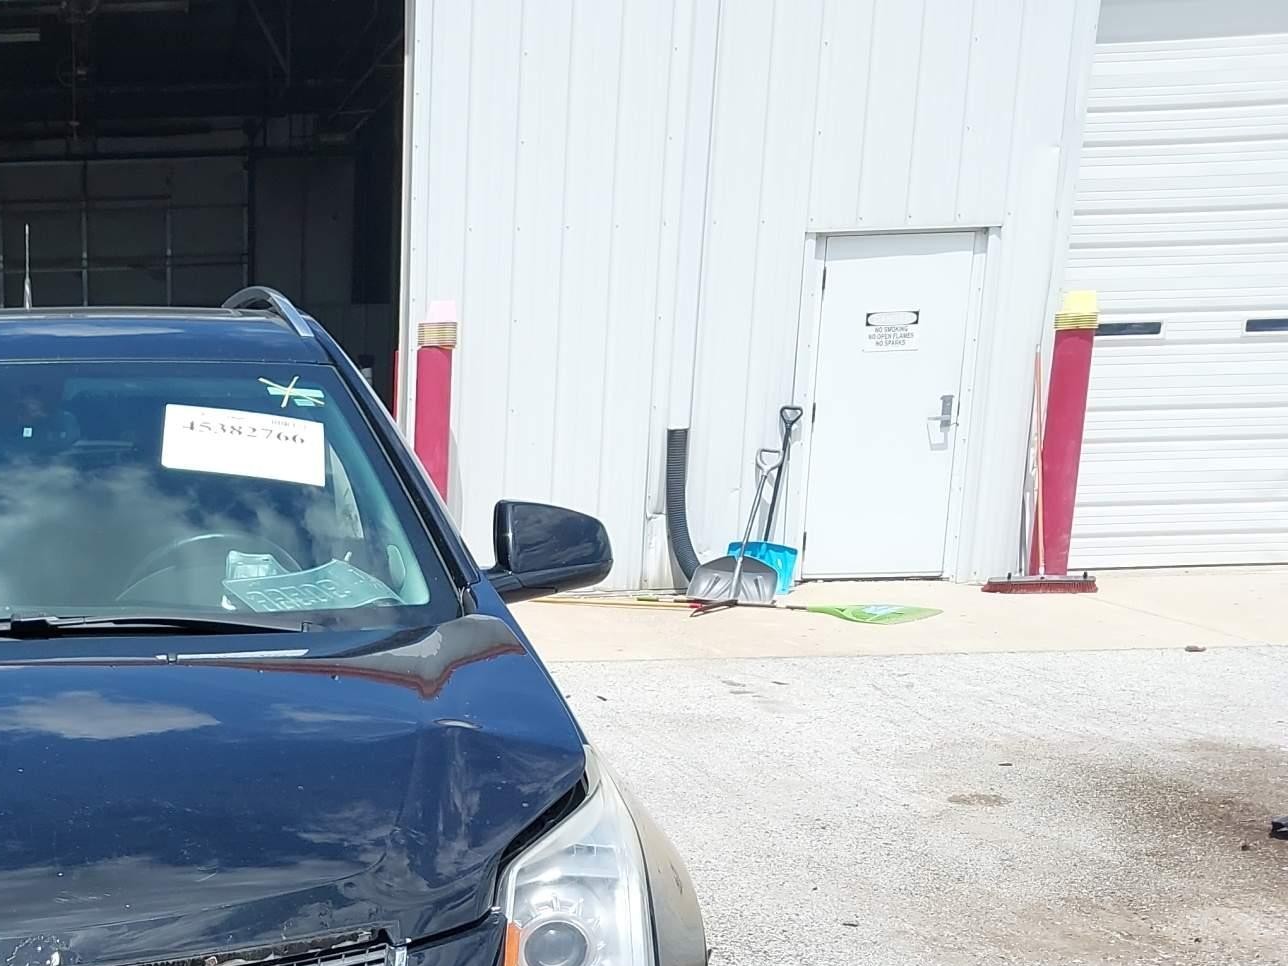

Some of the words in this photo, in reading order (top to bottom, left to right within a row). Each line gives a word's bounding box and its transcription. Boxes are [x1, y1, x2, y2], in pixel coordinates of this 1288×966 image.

[893, 332, 914, 340] FLAMES
[884, 339, 906, 347] SPARKS
[182, 420, 305, 444] 45382766
